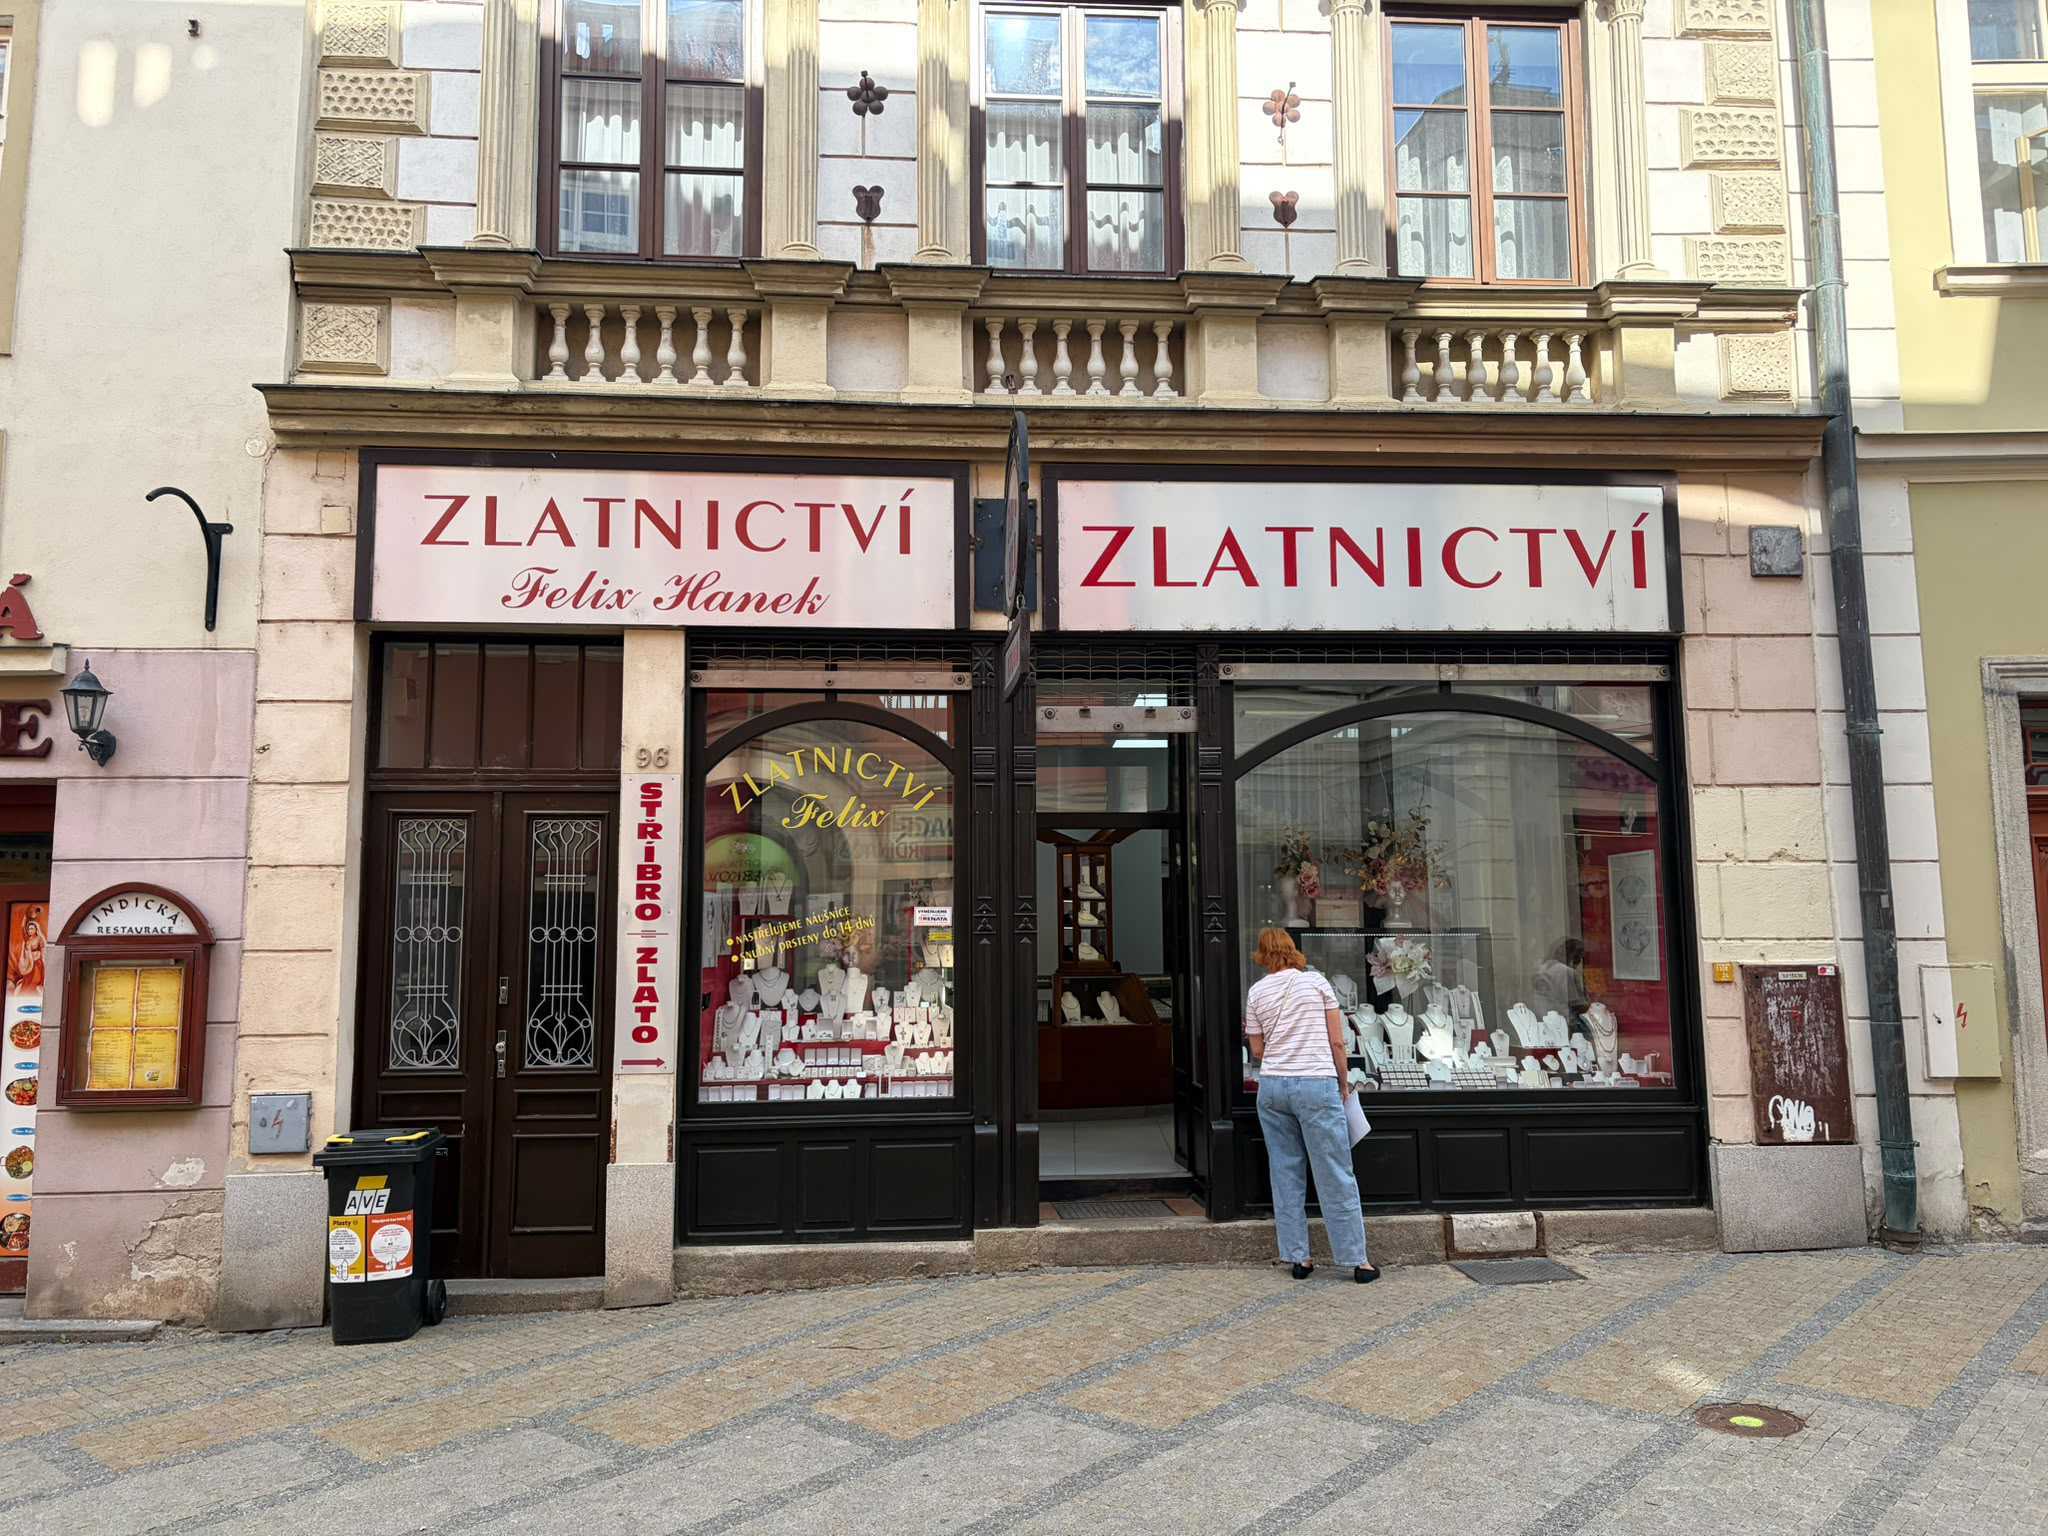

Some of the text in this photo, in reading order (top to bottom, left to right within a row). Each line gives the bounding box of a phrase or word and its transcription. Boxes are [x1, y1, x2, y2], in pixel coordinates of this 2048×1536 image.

[420, 488, 914, 554] ZLATNICTVÍ
[1080, 512, 1650, 589] ZLATNICTVÍ
[501, 566, 831, 615] Felix Hanek
[636, 747, 669, 768] 96
[720, 747, 943, 814] ZLATNICTVÍ
[782, 794, 890, 829] Felix
[635, 782, 663, 921] STŘÍBRO
[97, 926, 174, 934] RESTAURACE
[823, 925, 837, 939] do
[838, 920, 852, 934] 14
[632, 947, 660, 1044] ZLATO
[347, 1195, 386, 1209] AVE
